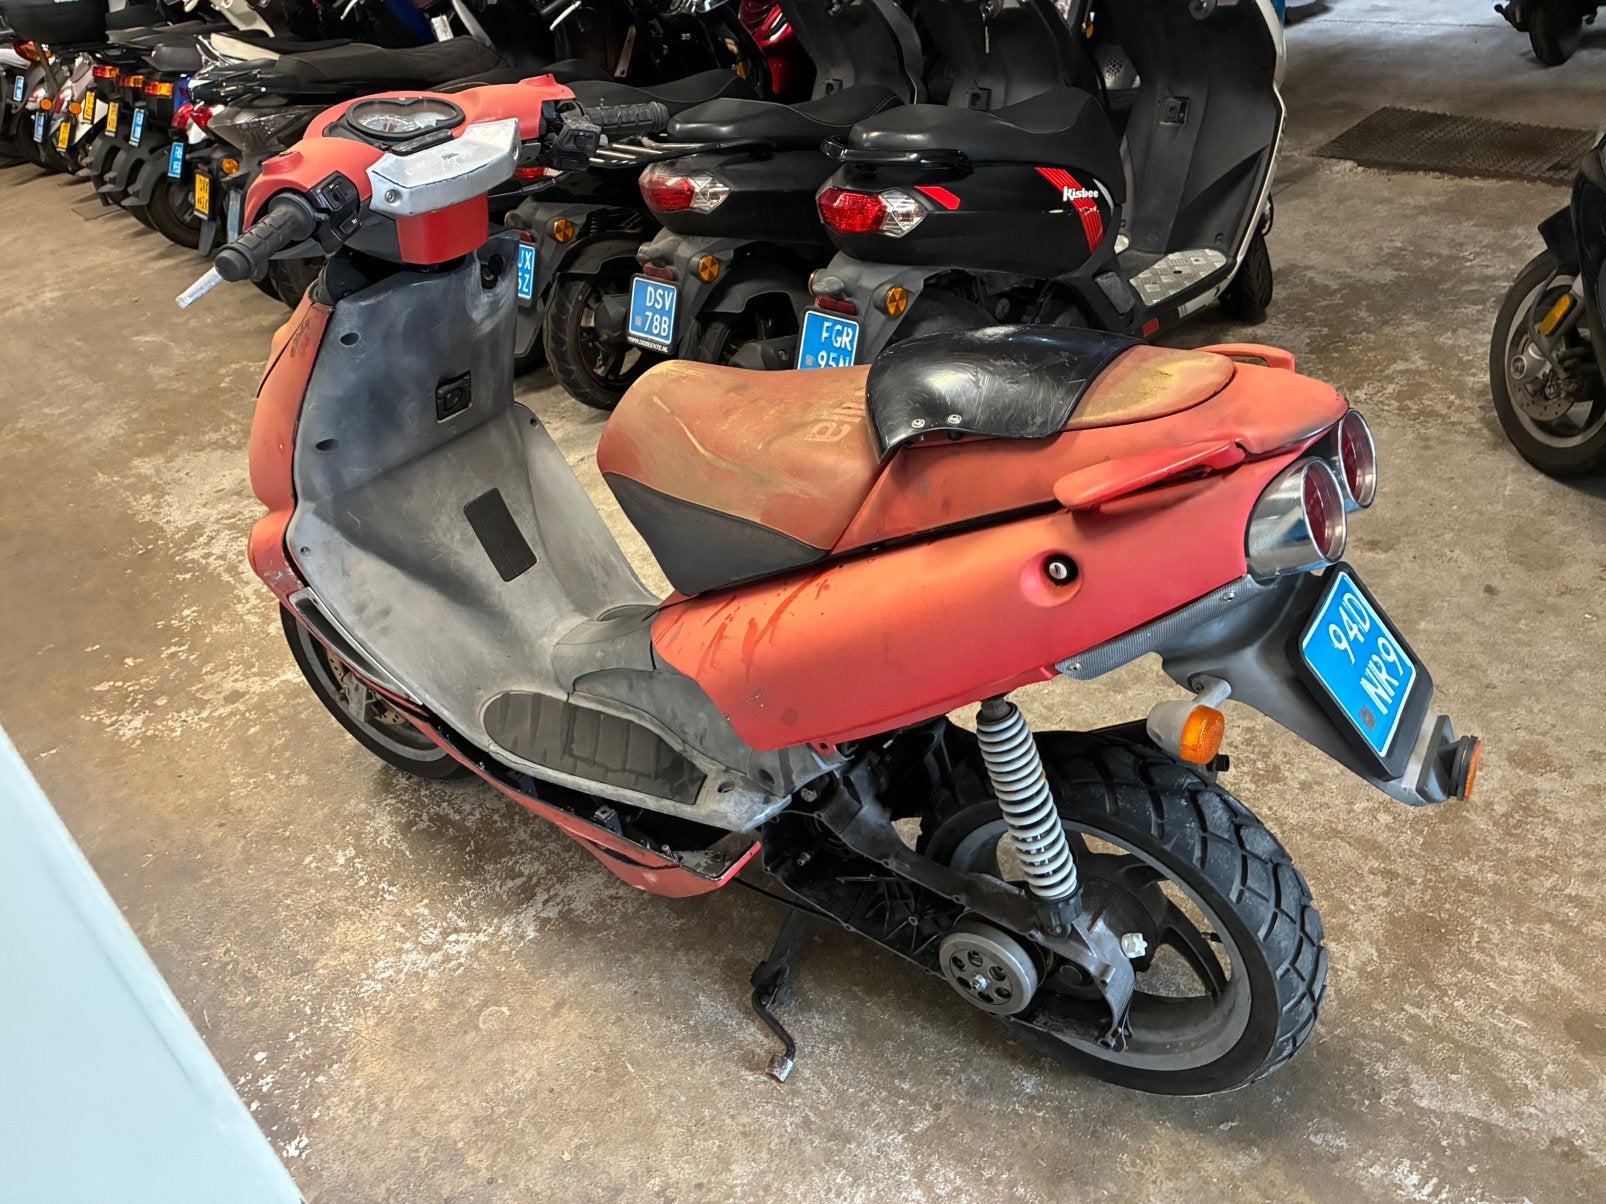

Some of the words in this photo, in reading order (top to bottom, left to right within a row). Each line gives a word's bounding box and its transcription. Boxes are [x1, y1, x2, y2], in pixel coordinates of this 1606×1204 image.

[1063, 186, 1099, 201] Kisbee
[646, 286, 673, 311] DSV
[644, 311, 669, 337] 78B
[821, 321, 853, 351] FGR
[1328, 592, 1371, 665] 94D
[1359, 636, 1404, 715] NR9
